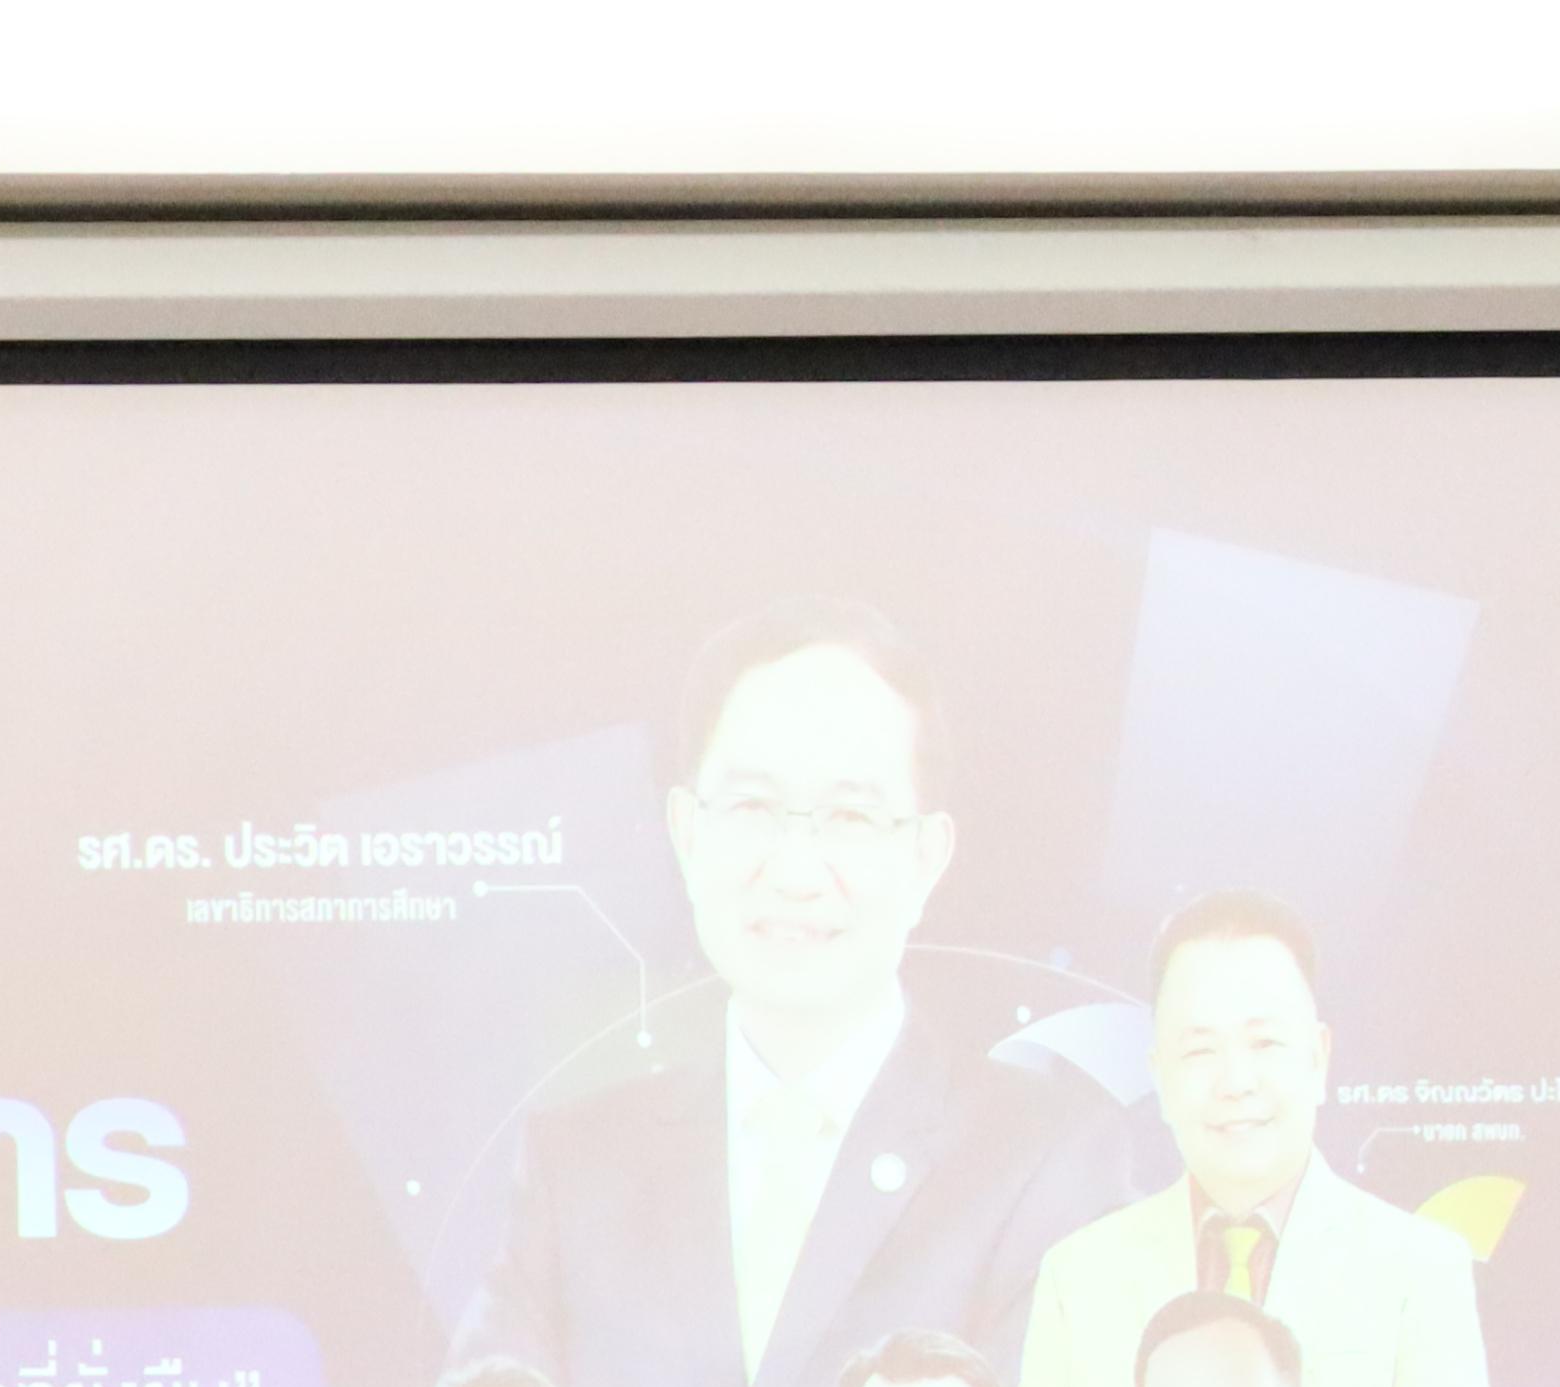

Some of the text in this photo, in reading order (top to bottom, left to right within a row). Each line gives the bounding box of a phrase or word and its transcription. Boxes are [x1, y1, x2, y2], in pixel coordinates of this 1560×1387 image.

[77, 815, 564, 870] รศ.ดร. ประวิต เอราวรรณ์
